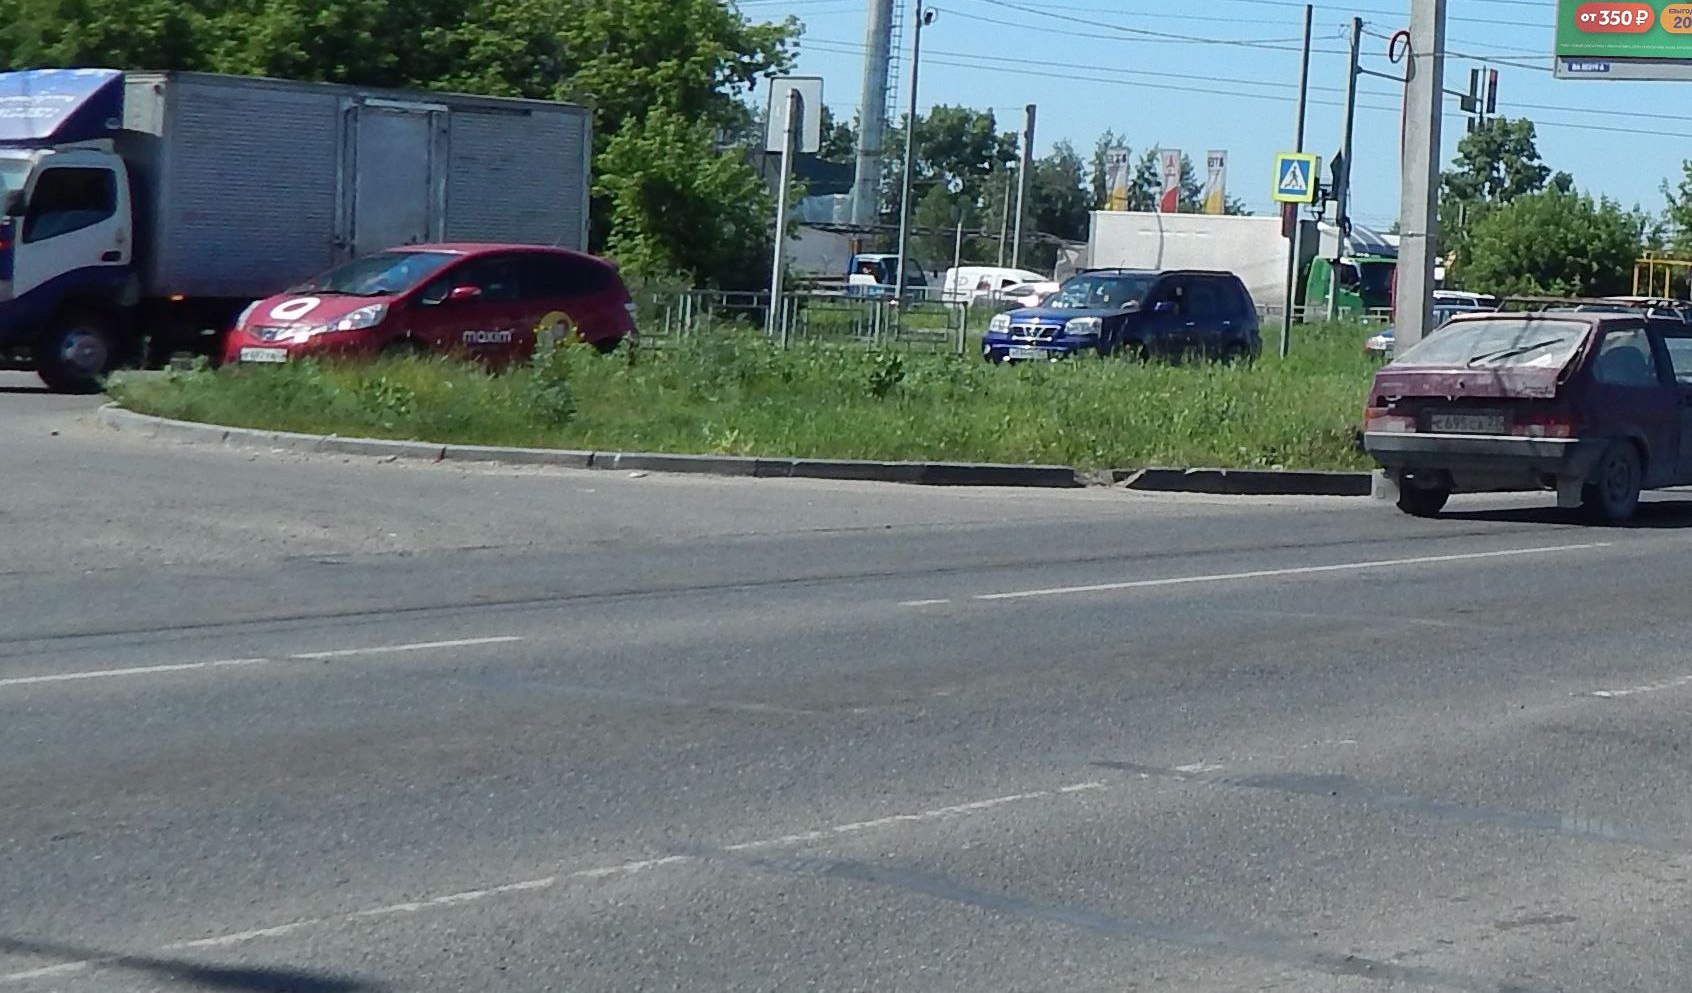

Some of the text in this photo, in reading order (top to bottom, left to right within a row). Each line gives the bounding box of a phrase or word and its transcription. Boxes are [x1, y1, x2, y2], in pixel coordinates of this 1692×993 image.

[1580, 12, 1597, 22] от
[1598, 10, 1633, 26] 350
[463, 327, 512, 343] maxim
